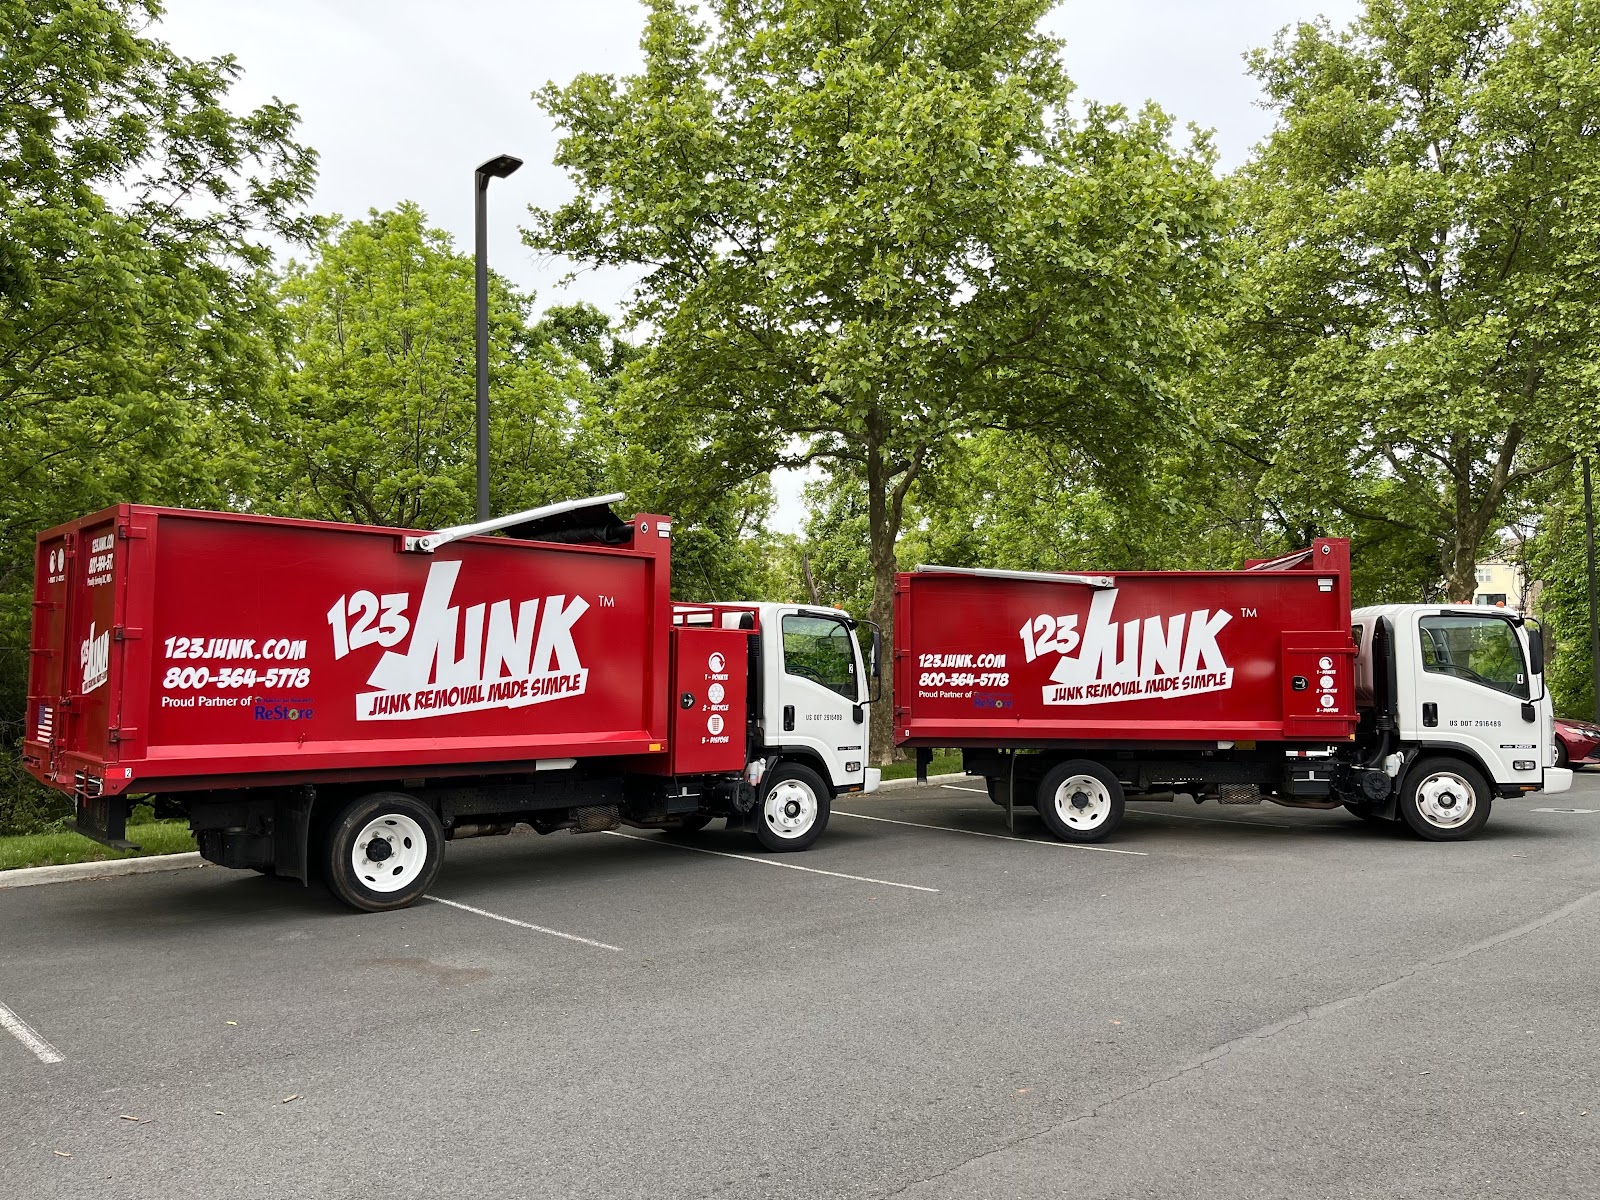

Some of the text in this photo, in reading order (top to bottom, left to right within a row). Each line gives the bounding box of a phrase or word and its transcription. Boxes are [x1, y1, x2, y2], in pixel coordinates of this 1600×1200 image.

[598, 595, 615, 607] TM
[1241, 607, 1257, 618] TM
[327, 560, 590, 690] 123 JUNK
[1019, 588, 1233, 685] 123 JUNK
[164, 636, 307, 660] 123JUNK.COM
[918, 653, 1006, 668] 123JUNK.COM
[162, 667, 311, 689] 800-364-5778
[918, 672, 1010, 687] 800-364-5778
[1052, 672, 1227, 702] JUNK REMOVAL MADE SIMPLE
[161, 696, 195, 708] Proud
[198, 696, 237, 707] Partner
[240, 696, 252, 706] of
[368, 673, 581, 716] JUNK REMOVAL MADE SIMPLE
[255, 705, 314, 720] ReStore
